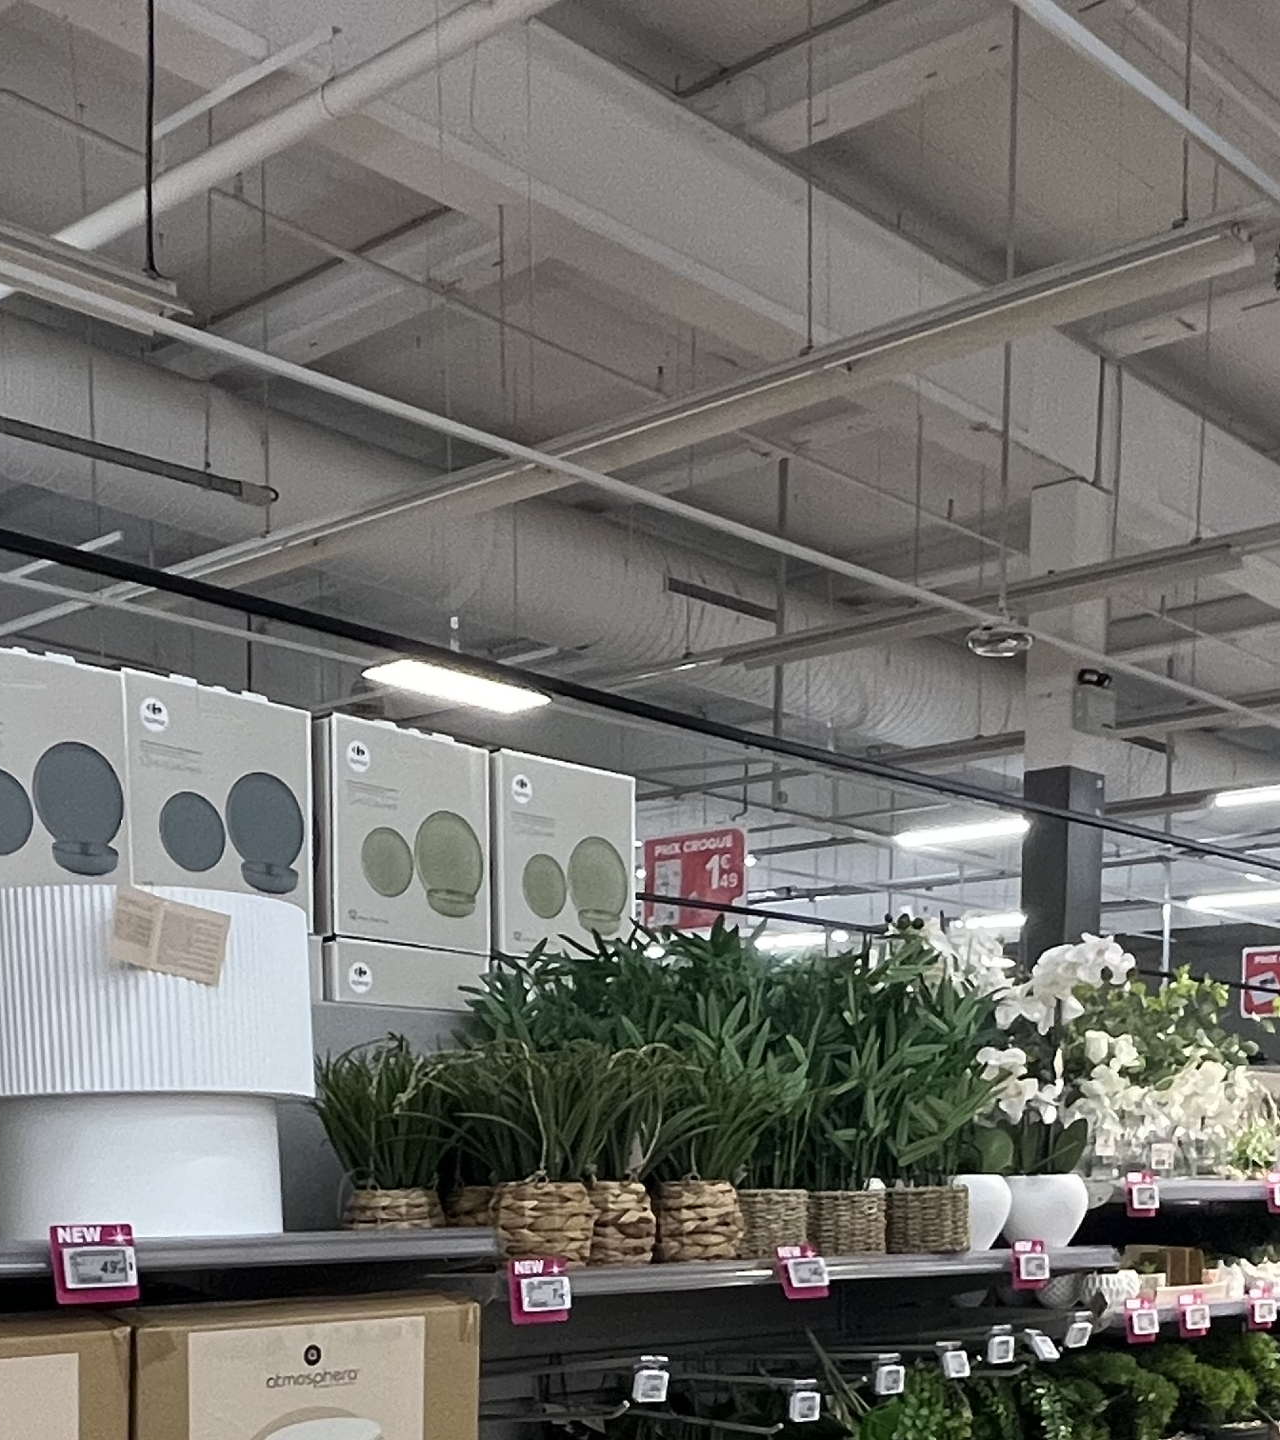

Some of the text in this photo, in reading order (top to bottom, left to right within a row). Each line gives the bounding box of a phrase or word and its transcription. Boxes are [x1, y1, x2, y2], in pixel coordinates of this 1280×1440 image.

[653, 842, 681, 857] PRIX
[57, 1227, 101, 1244] NEW
[514, 1259, 545, 1275] NEW
[265, 1368, 360, 1389] atmosphera
